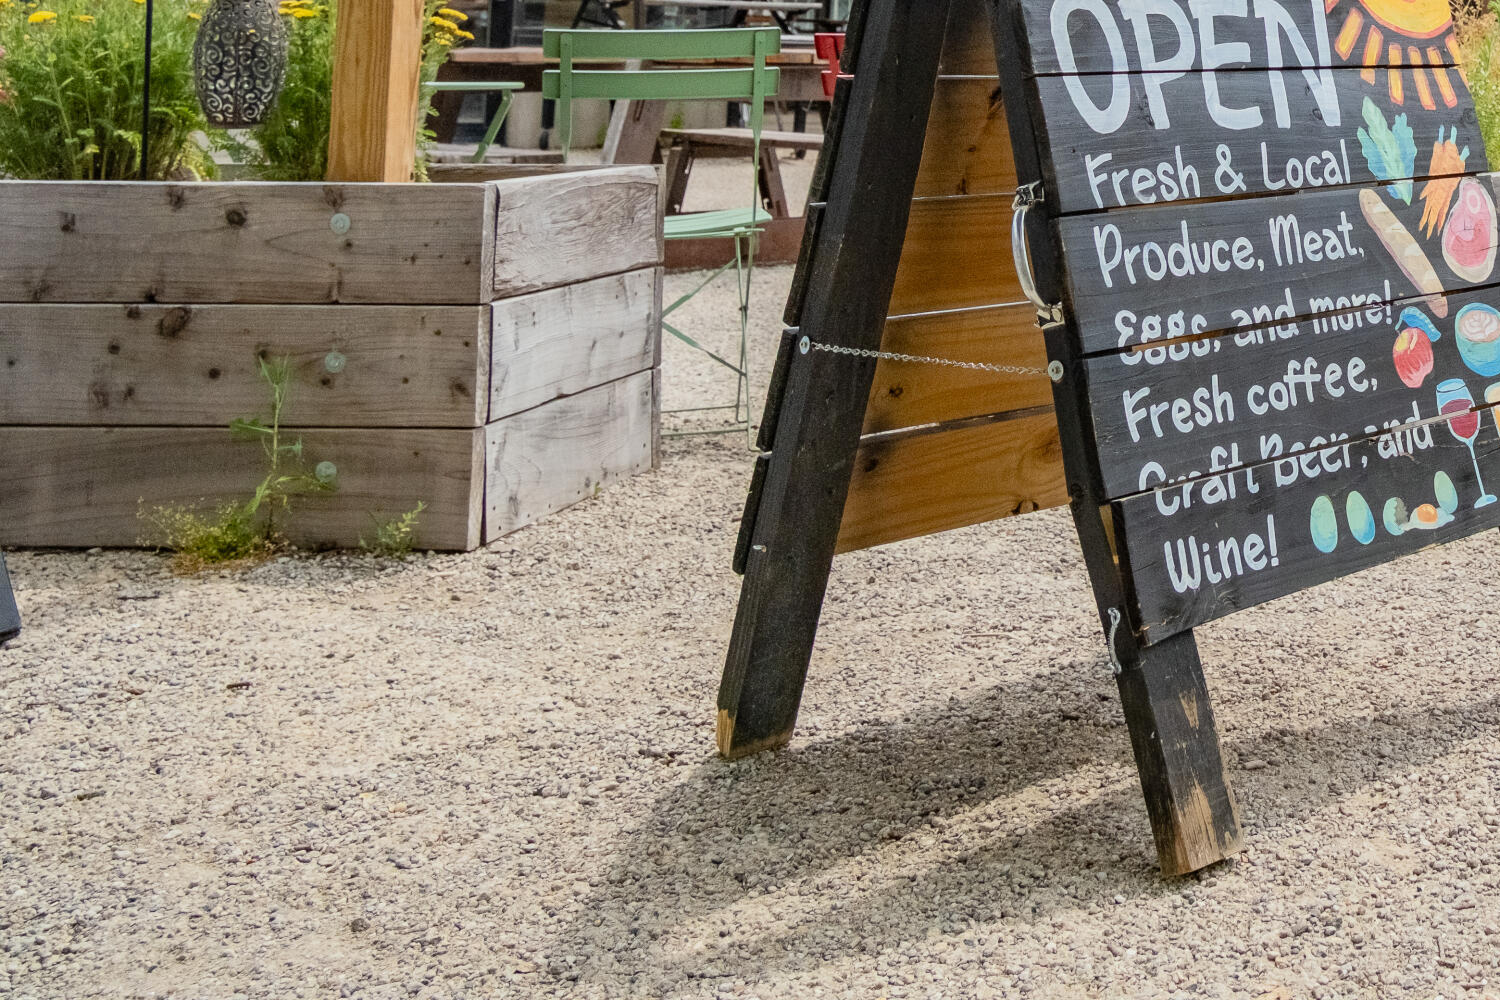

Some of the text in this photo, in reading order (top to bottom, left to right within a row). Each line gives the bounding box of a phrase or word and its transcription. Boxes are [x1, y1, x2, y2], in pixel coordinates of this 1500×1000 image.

[1085, 138, 1351, 208] Fresh & Local
[1092, 210, 1365, 289] Produce, Meat,
[1114, 279, 1393, 366] Eggs, and more!
[1122, 356, 1378, 443] Fresh coffee,
[1138, 400, 1435, 516] Craft Beer, and
[1163, 513, 1280, 593] Wine!
